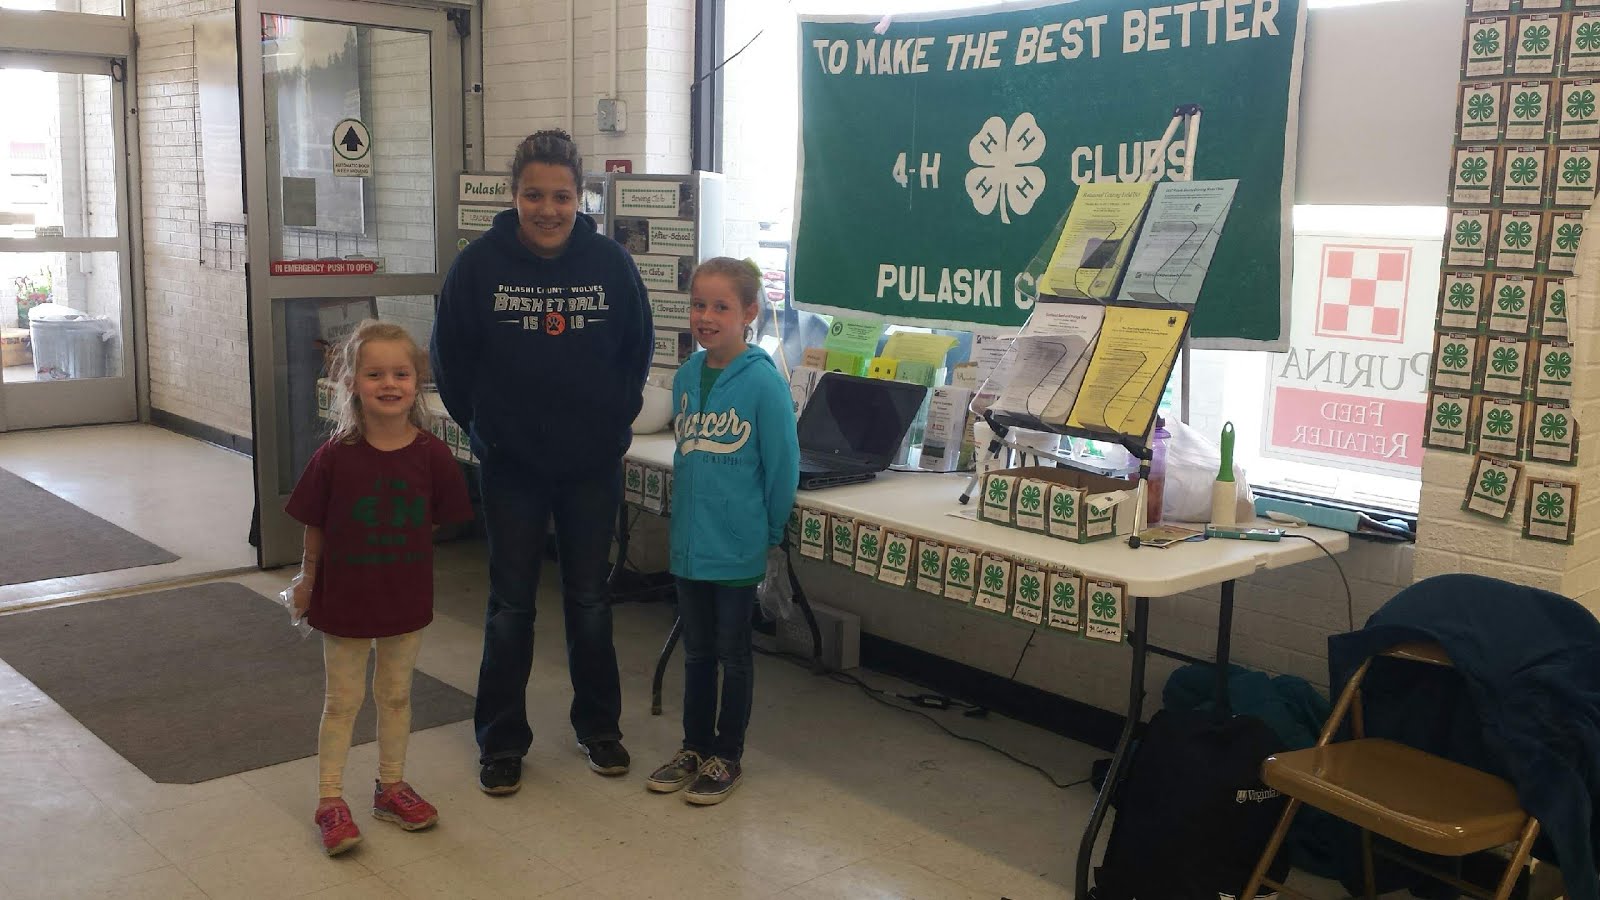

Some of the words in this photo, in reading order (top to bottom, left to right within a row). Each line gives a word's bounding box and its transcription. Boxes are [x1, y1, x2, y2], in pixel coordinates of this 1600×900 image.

[812, 39, 849, 75] TO
[855, 37, 936, 75] MAKE
[946, 30, 1008, 72] THE
[1015, 14, 1108, 66] BEST
[1122, 0, 1280, 54] BETTER
[980, 132, 998, 154] H
[1017, 127, 1036, 151] H
[892, 152, 942, 189] 4-H
[1071, 139, 1194, 186] CLUBS
[464, 182, 506, 195] Pulaski
[976, 176, 993, 198] H
[1016, 176, 1034, 198] H
[275, 264, 282, 272] IN
[283, 264, 324, 272] EMERGENCY
[327, 264, 344, 272] PUSH
[346, 263, 354, 271] TO
[356, 263, 373, 271] OPEN
[498, 284, 535, 293] PULASKI
[537, 286, 568, 294] CUNT
[571, 285, 604, 293] WOLVES
[876, 263, 1002, 308] PULASKI
[493, 291, 610, 313] BASKETBALL
[523, 315, 539, 330] 15
